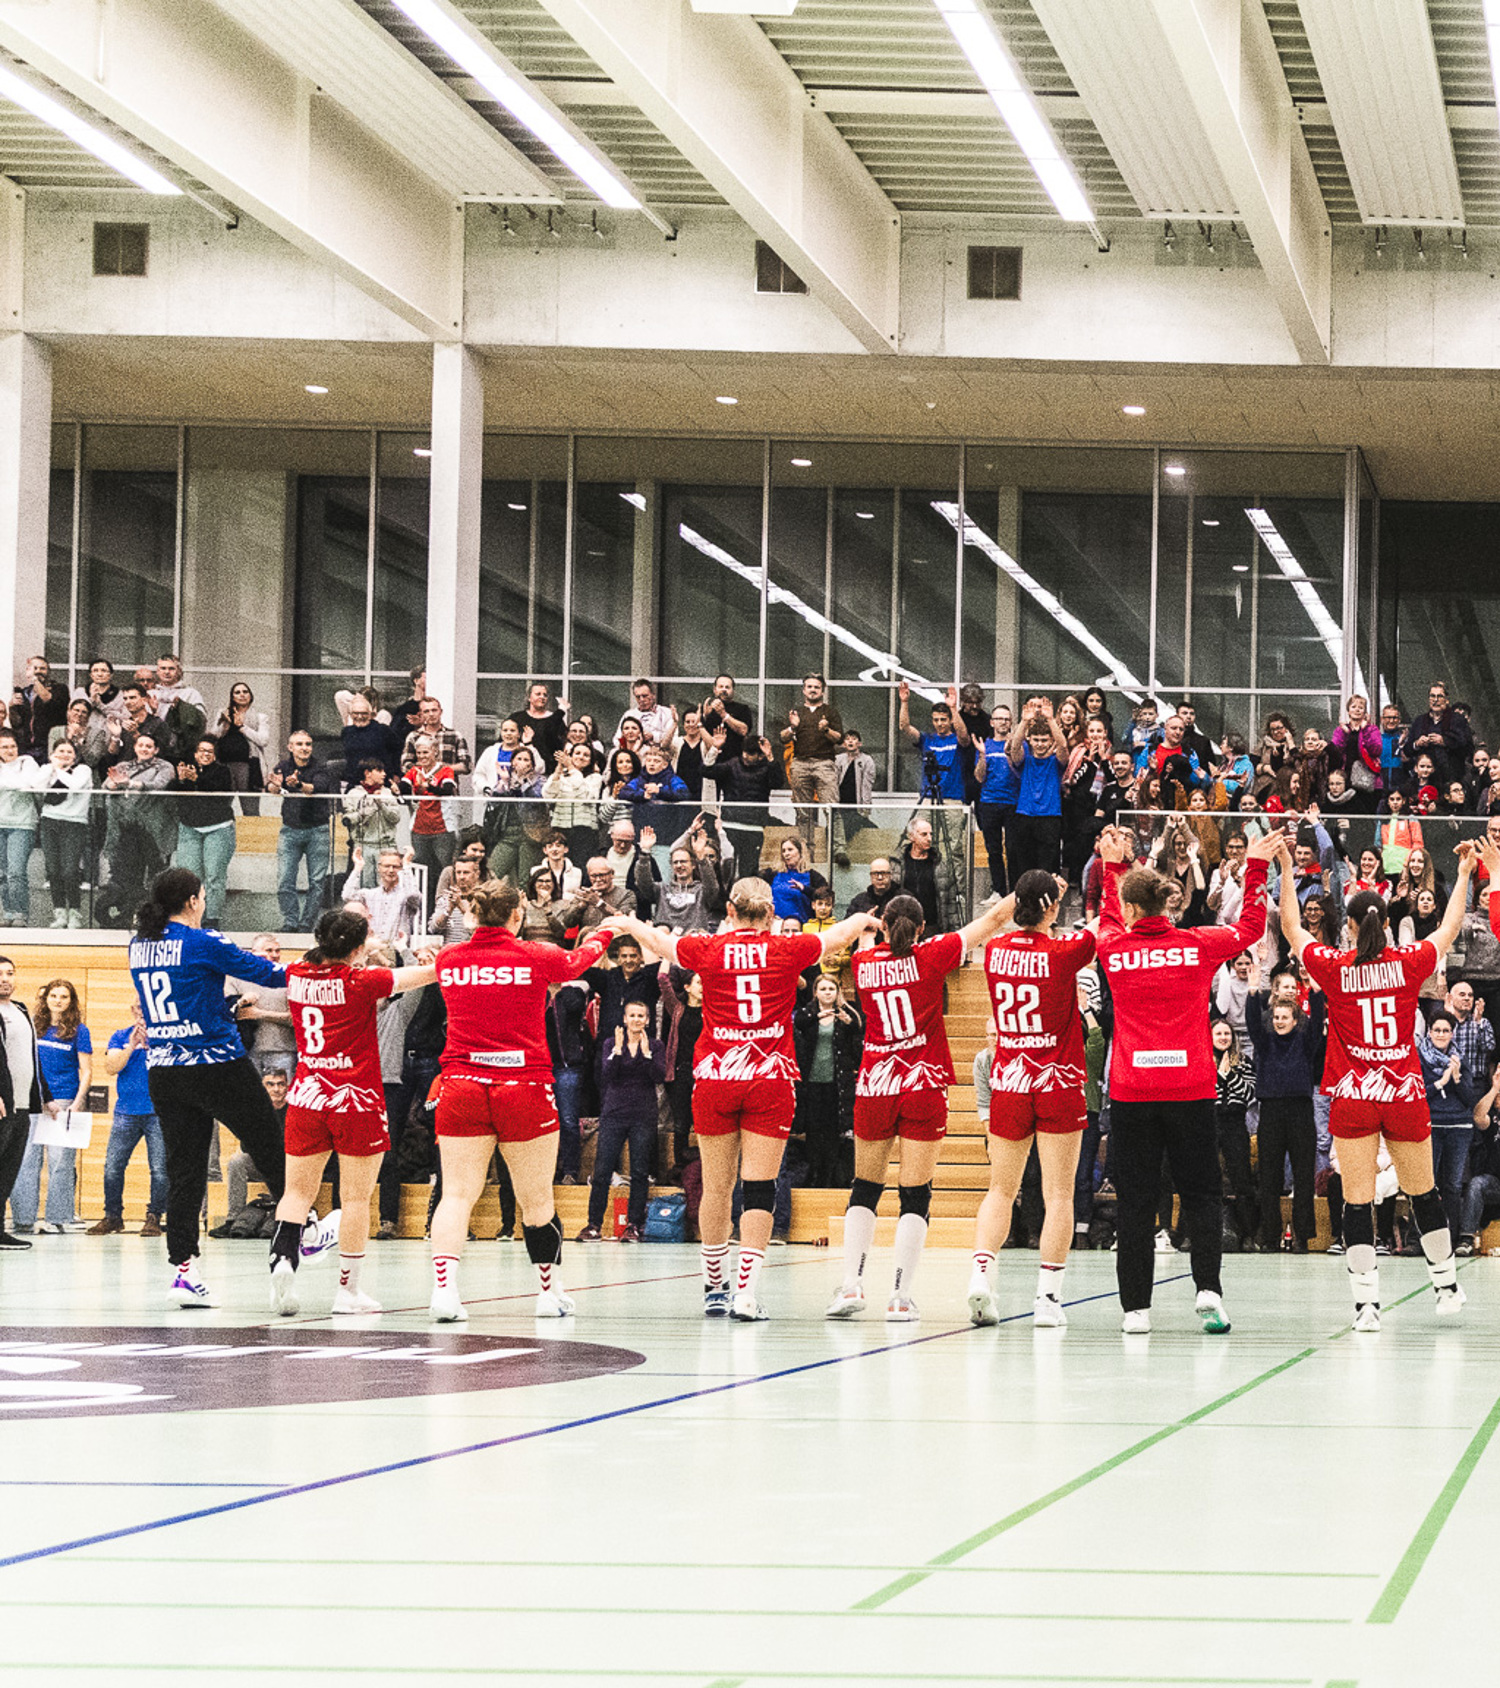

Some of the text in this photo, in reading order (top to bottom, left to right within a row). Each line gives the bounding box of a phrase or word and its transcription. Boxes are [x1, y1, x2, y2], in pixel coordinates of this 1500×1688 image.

[724, 942, 768, 969] FREY
[858, 955, 920, 989] GAUTSCHI
[989, 948, 1049, 978] BUCHER
[1109, 947, 1199, 973] SUISSE
[441, 964, 532, 987] SUISSE
[1340, 960, 1406, 992] GOLDMANN
[138, 971, 179, 1023] 12
[736, 974, 762, 1024] 5
[996, 982, 1042, 1033] 22
[301, 1006, 325, 1054] 8
[871, 989, 916, 1041] 10
[1356, 996, 1398, 1047] 15
[1136, 1052, 1185, 1065] CONCORDIA
